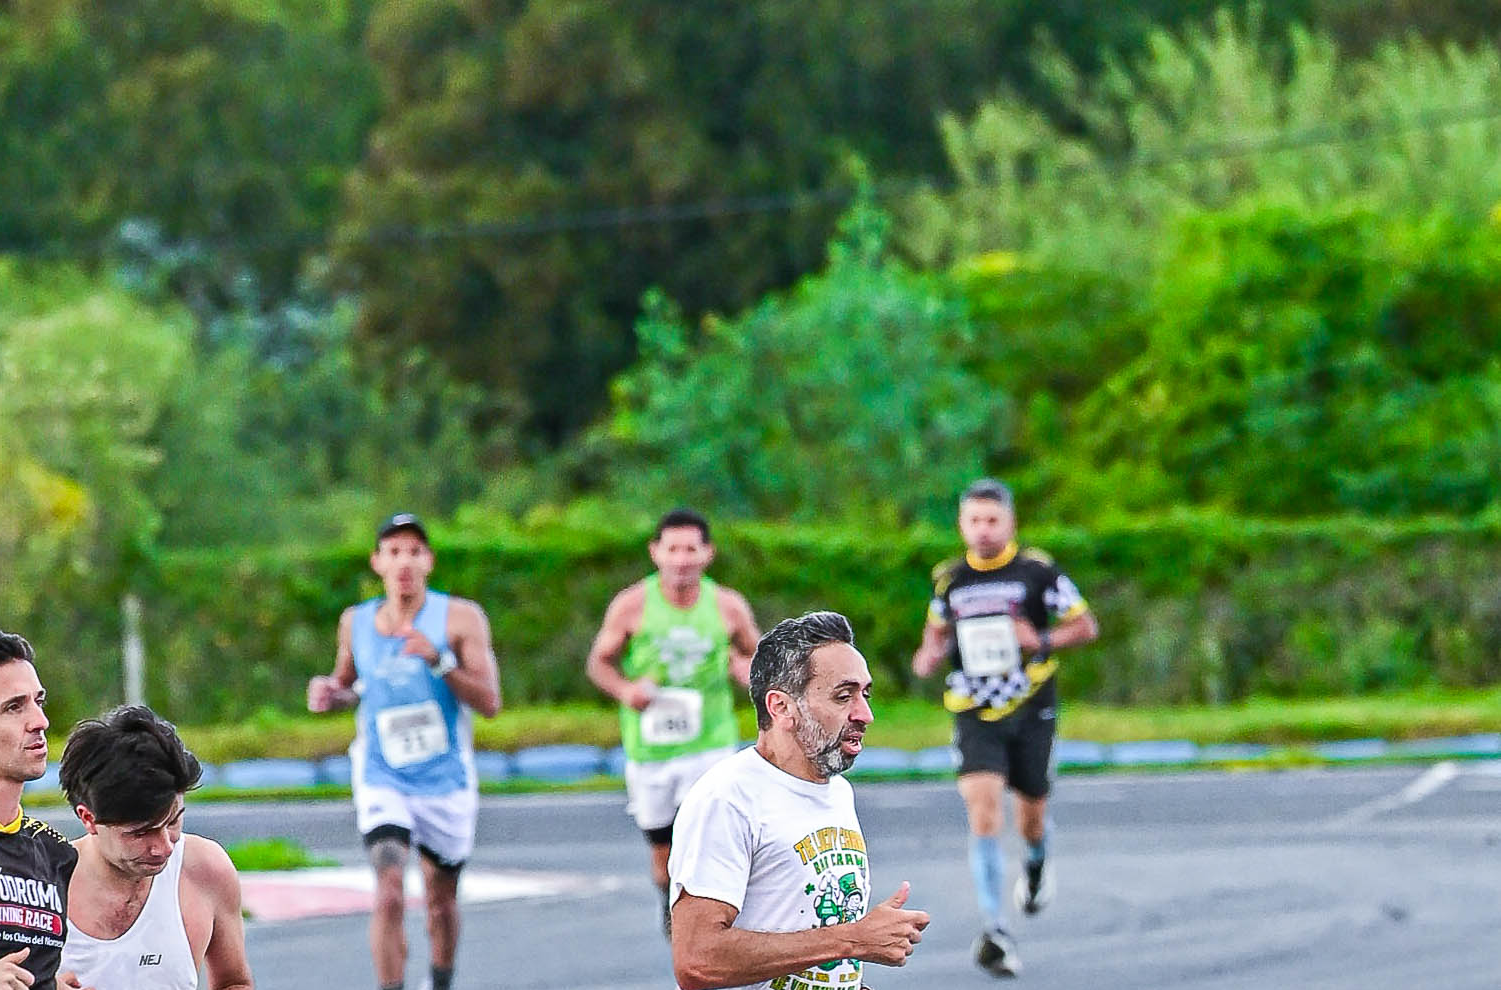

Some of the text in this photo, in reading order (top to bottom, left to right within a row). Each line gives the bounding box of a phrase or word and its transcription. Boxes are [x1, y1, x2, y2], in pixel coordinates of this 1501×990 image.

[830, 853, 865, 868] CRAW
[25, 909, 53, 931] RACE
[3, 930, 14, 941] los
[32, 935, 44, 945] del
